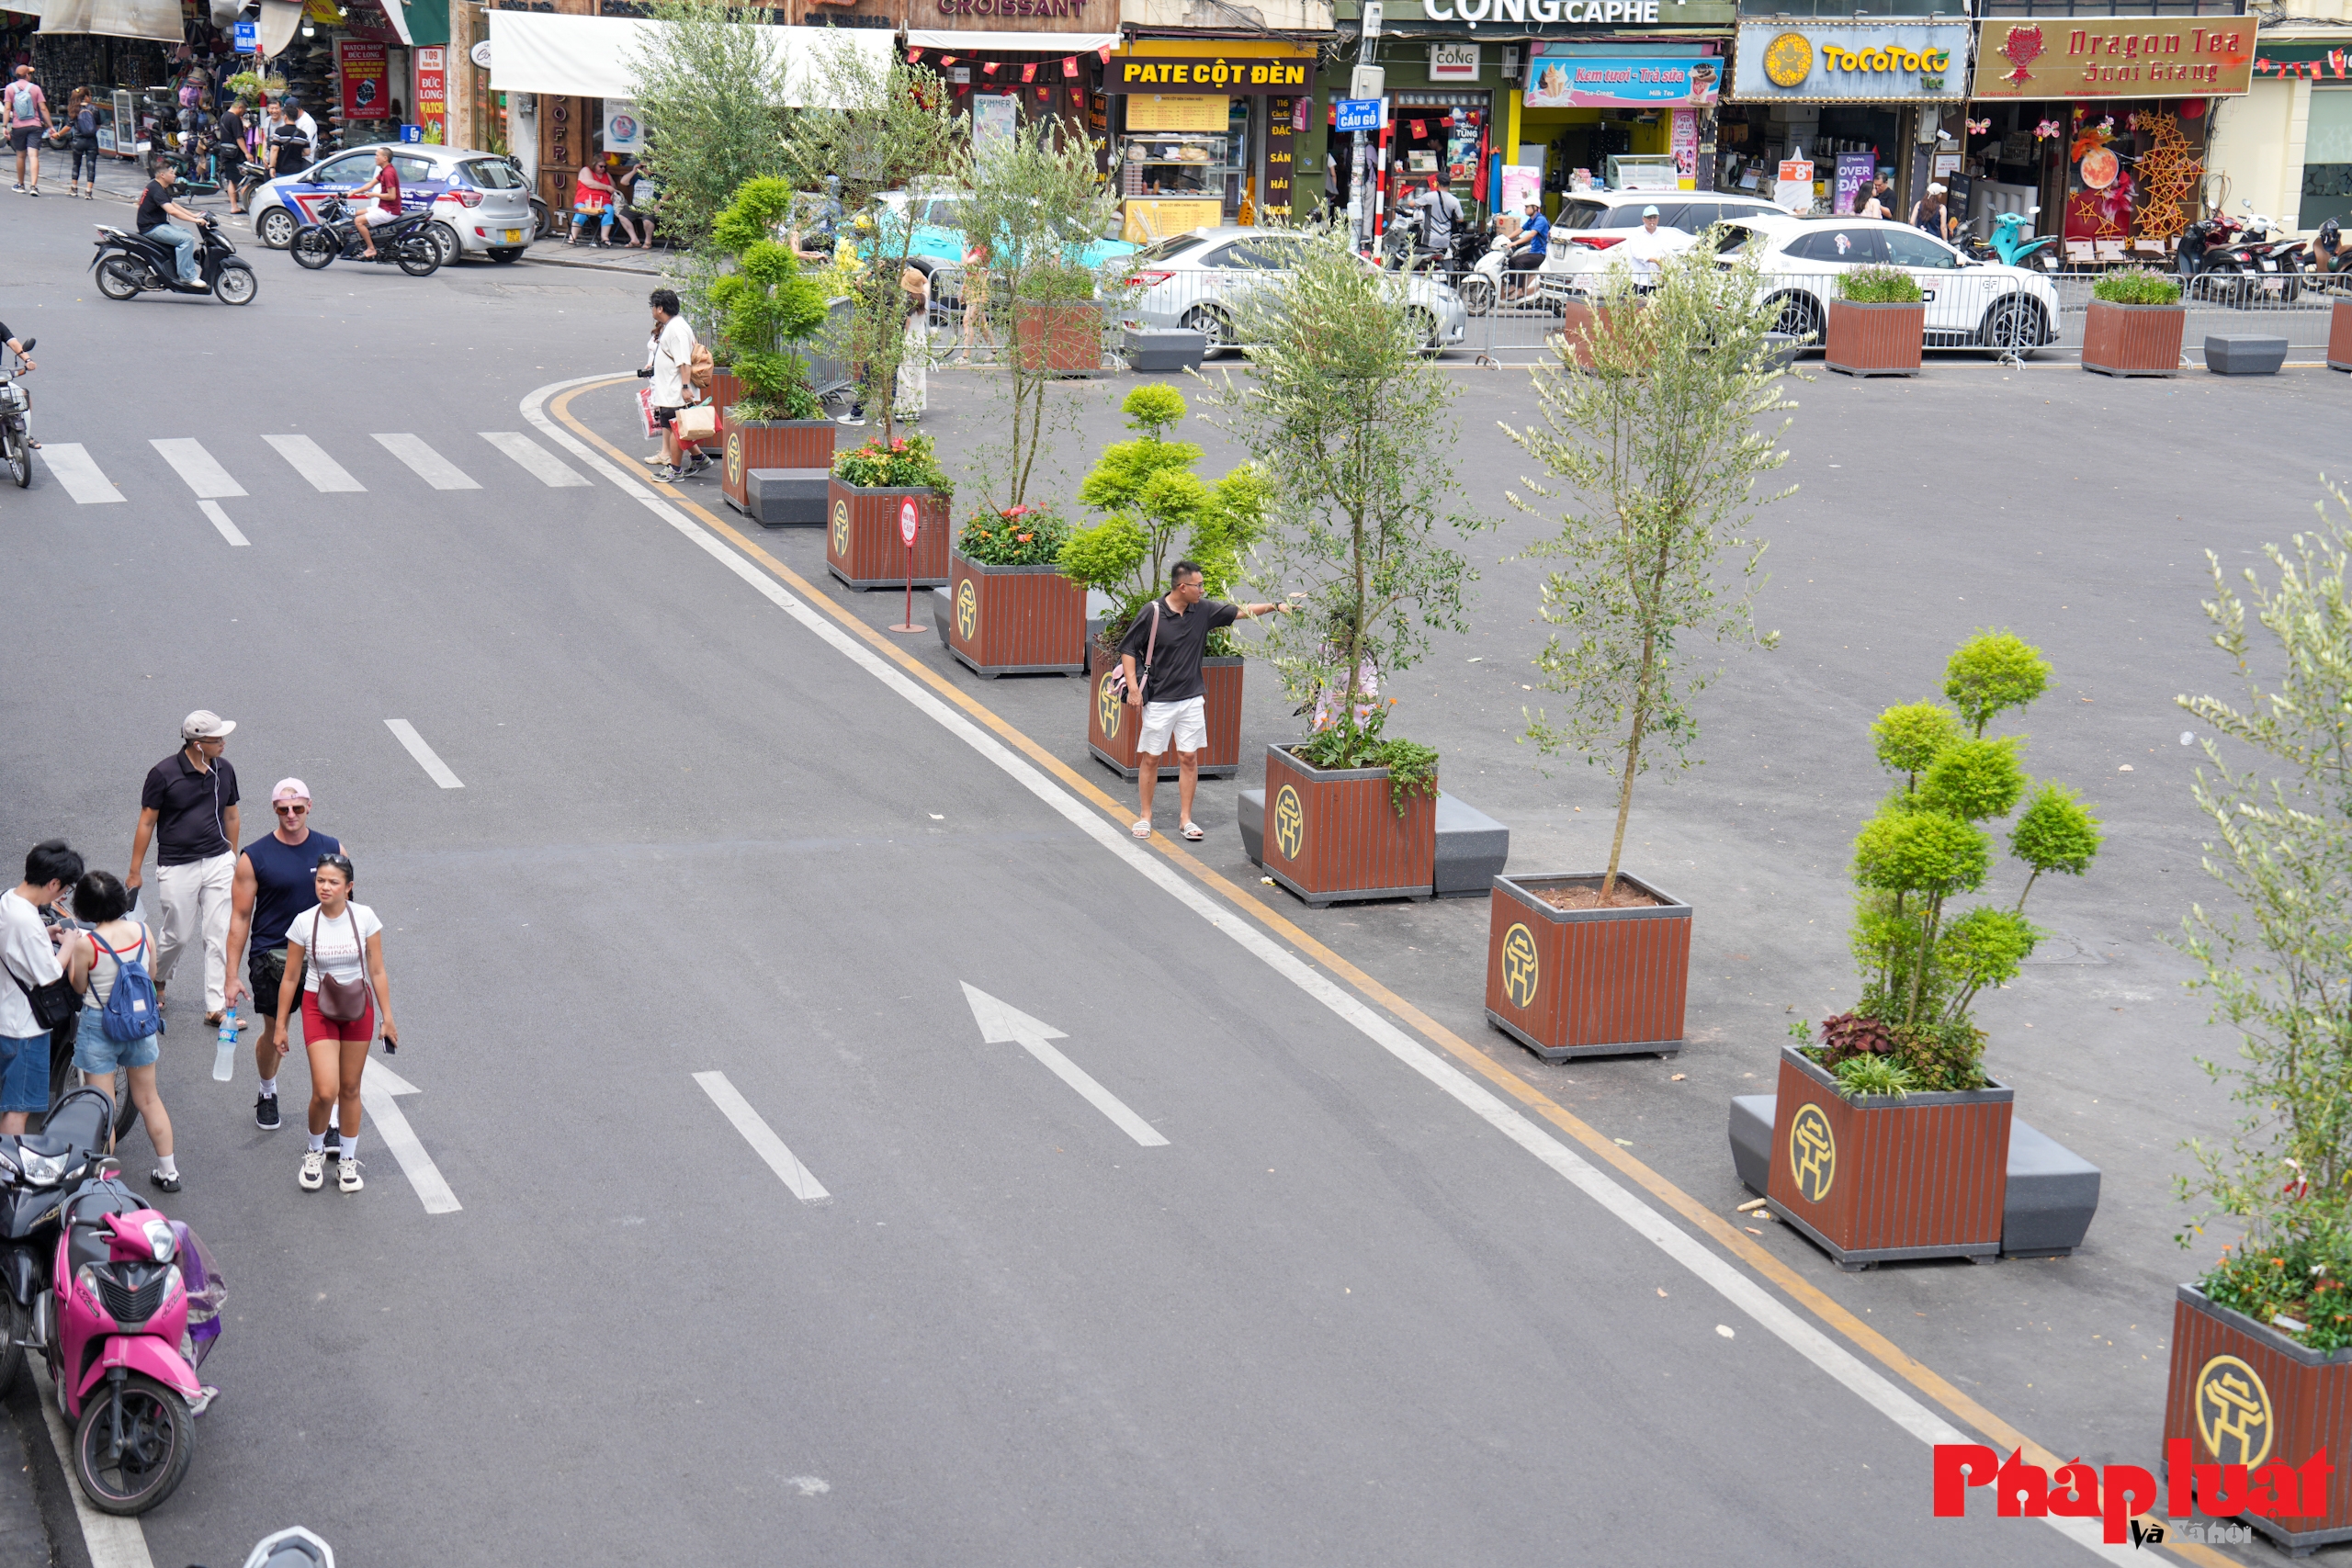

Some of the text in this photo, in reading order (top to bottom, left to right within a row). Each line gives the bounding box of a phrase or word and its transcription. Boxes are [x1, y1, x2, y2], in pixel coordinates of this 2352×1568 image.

[938, 0, 1087, 17] CROISSANT
[1564, 0, 1659, 23] CAPHE
[2066, 28, 2240, 59] Dragon Tea
[424, 51, 438, 60] 109
[1124, 58, 1305, 88] PATE CỘT ĐÈN
[1575, 67, 1602, 83] Kem
[1604, 67, 1631, 82] tươi
[1639, 67, 1660, 83] Trà
[1661, 68, 1684, 83] sữa
[422, 76, 441, 88] ĐỨC
[1921, 75, 1944, 89] Tea
[419, 90, 443, 99] LONG
[419, 102, 444, 113] WATCH
[1356, 102, 1370, 111] PHỐ
[1340, 110, 1376, 127] CẦU GỖ
[1271, 124, 1291, 136] ĐẶC
[1270, 150, 1291, 163] SẢN
[1838, 166, 1871, 176] OVER
[1270, 177, 1288, 189] HẢI
